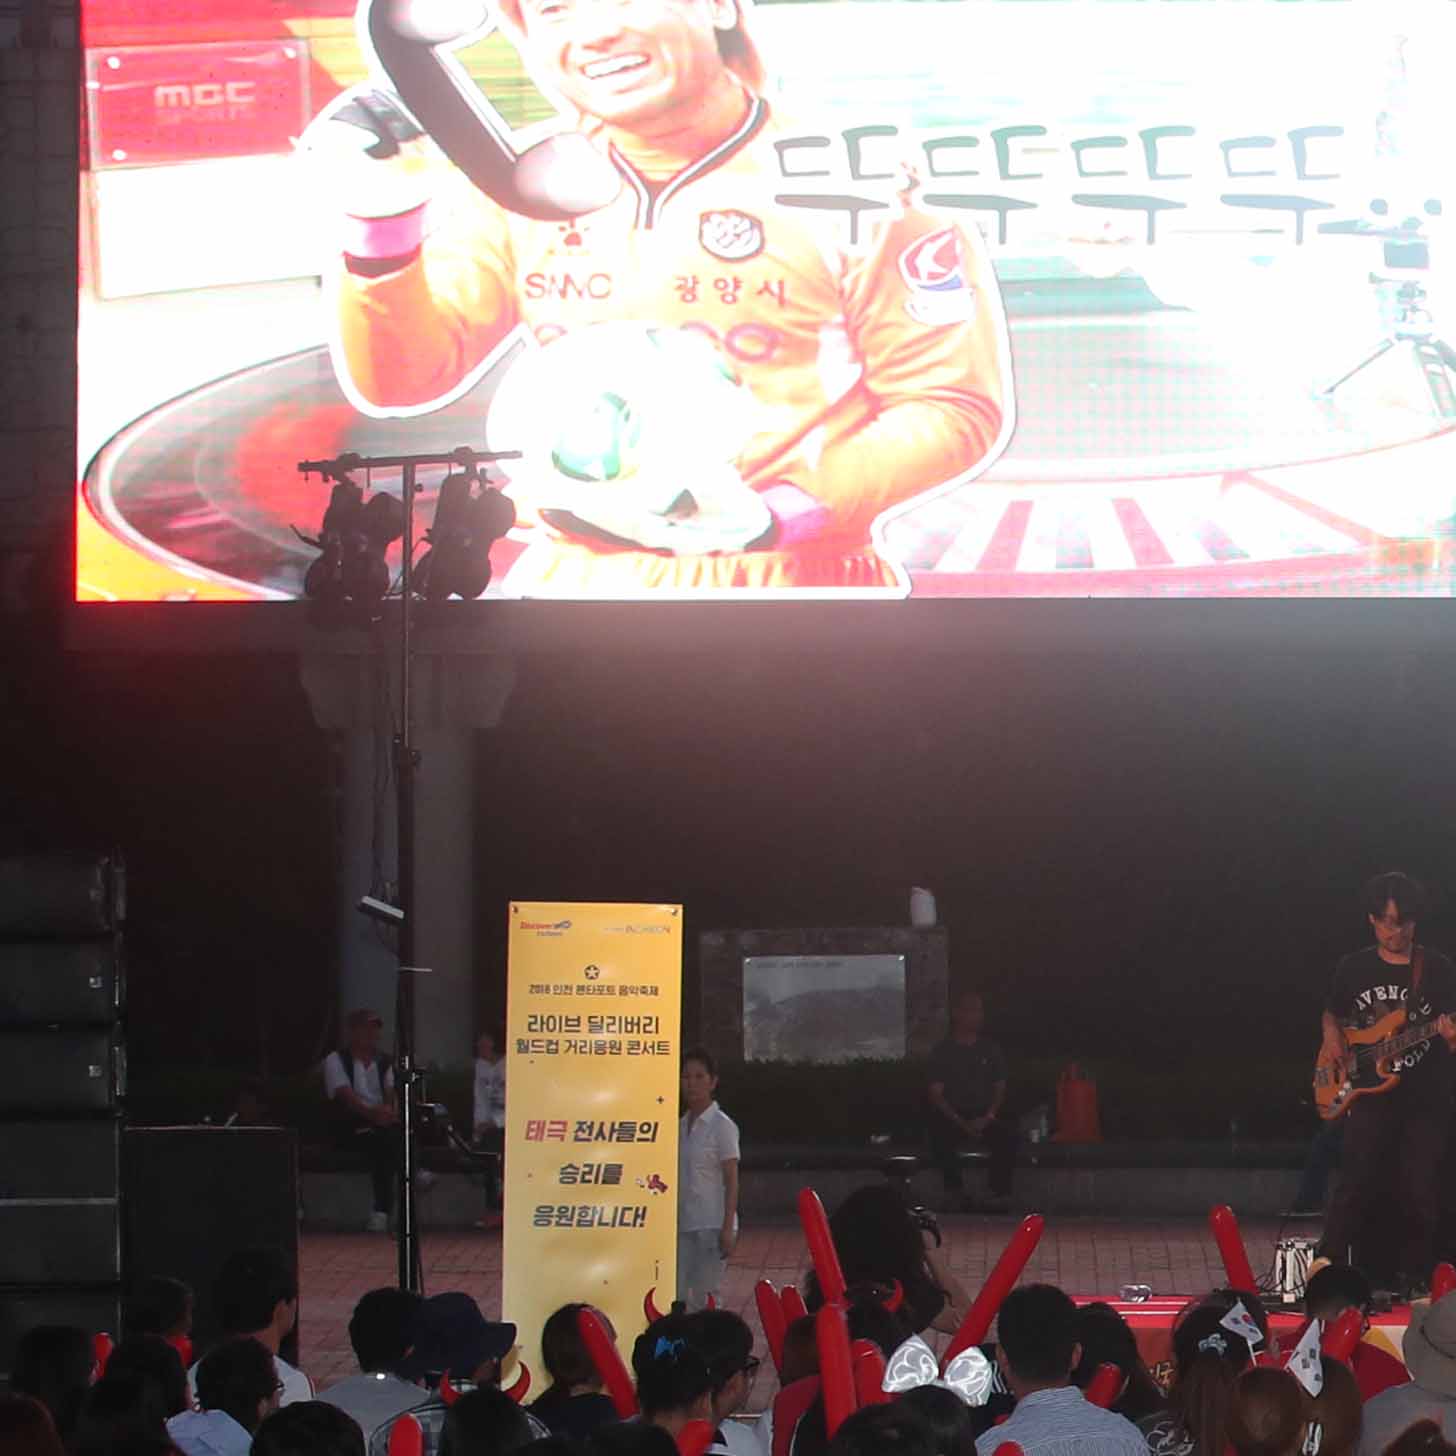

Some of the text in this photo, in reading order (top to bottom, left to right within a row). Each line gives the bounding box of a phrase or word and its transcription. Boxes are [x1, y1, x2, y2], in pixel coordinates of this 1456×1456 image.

[527, 1013, 660, 1035] 라이브 딜리버리
[516, 1038, 671, 1056] 월드컵 거리응원 콘서트
[525, 1119, 660, 1143] 태극 전사들의
[558, 1163, 624, 1185] 승리를
[532, 1205, 648, 1228] 응원합니다!
